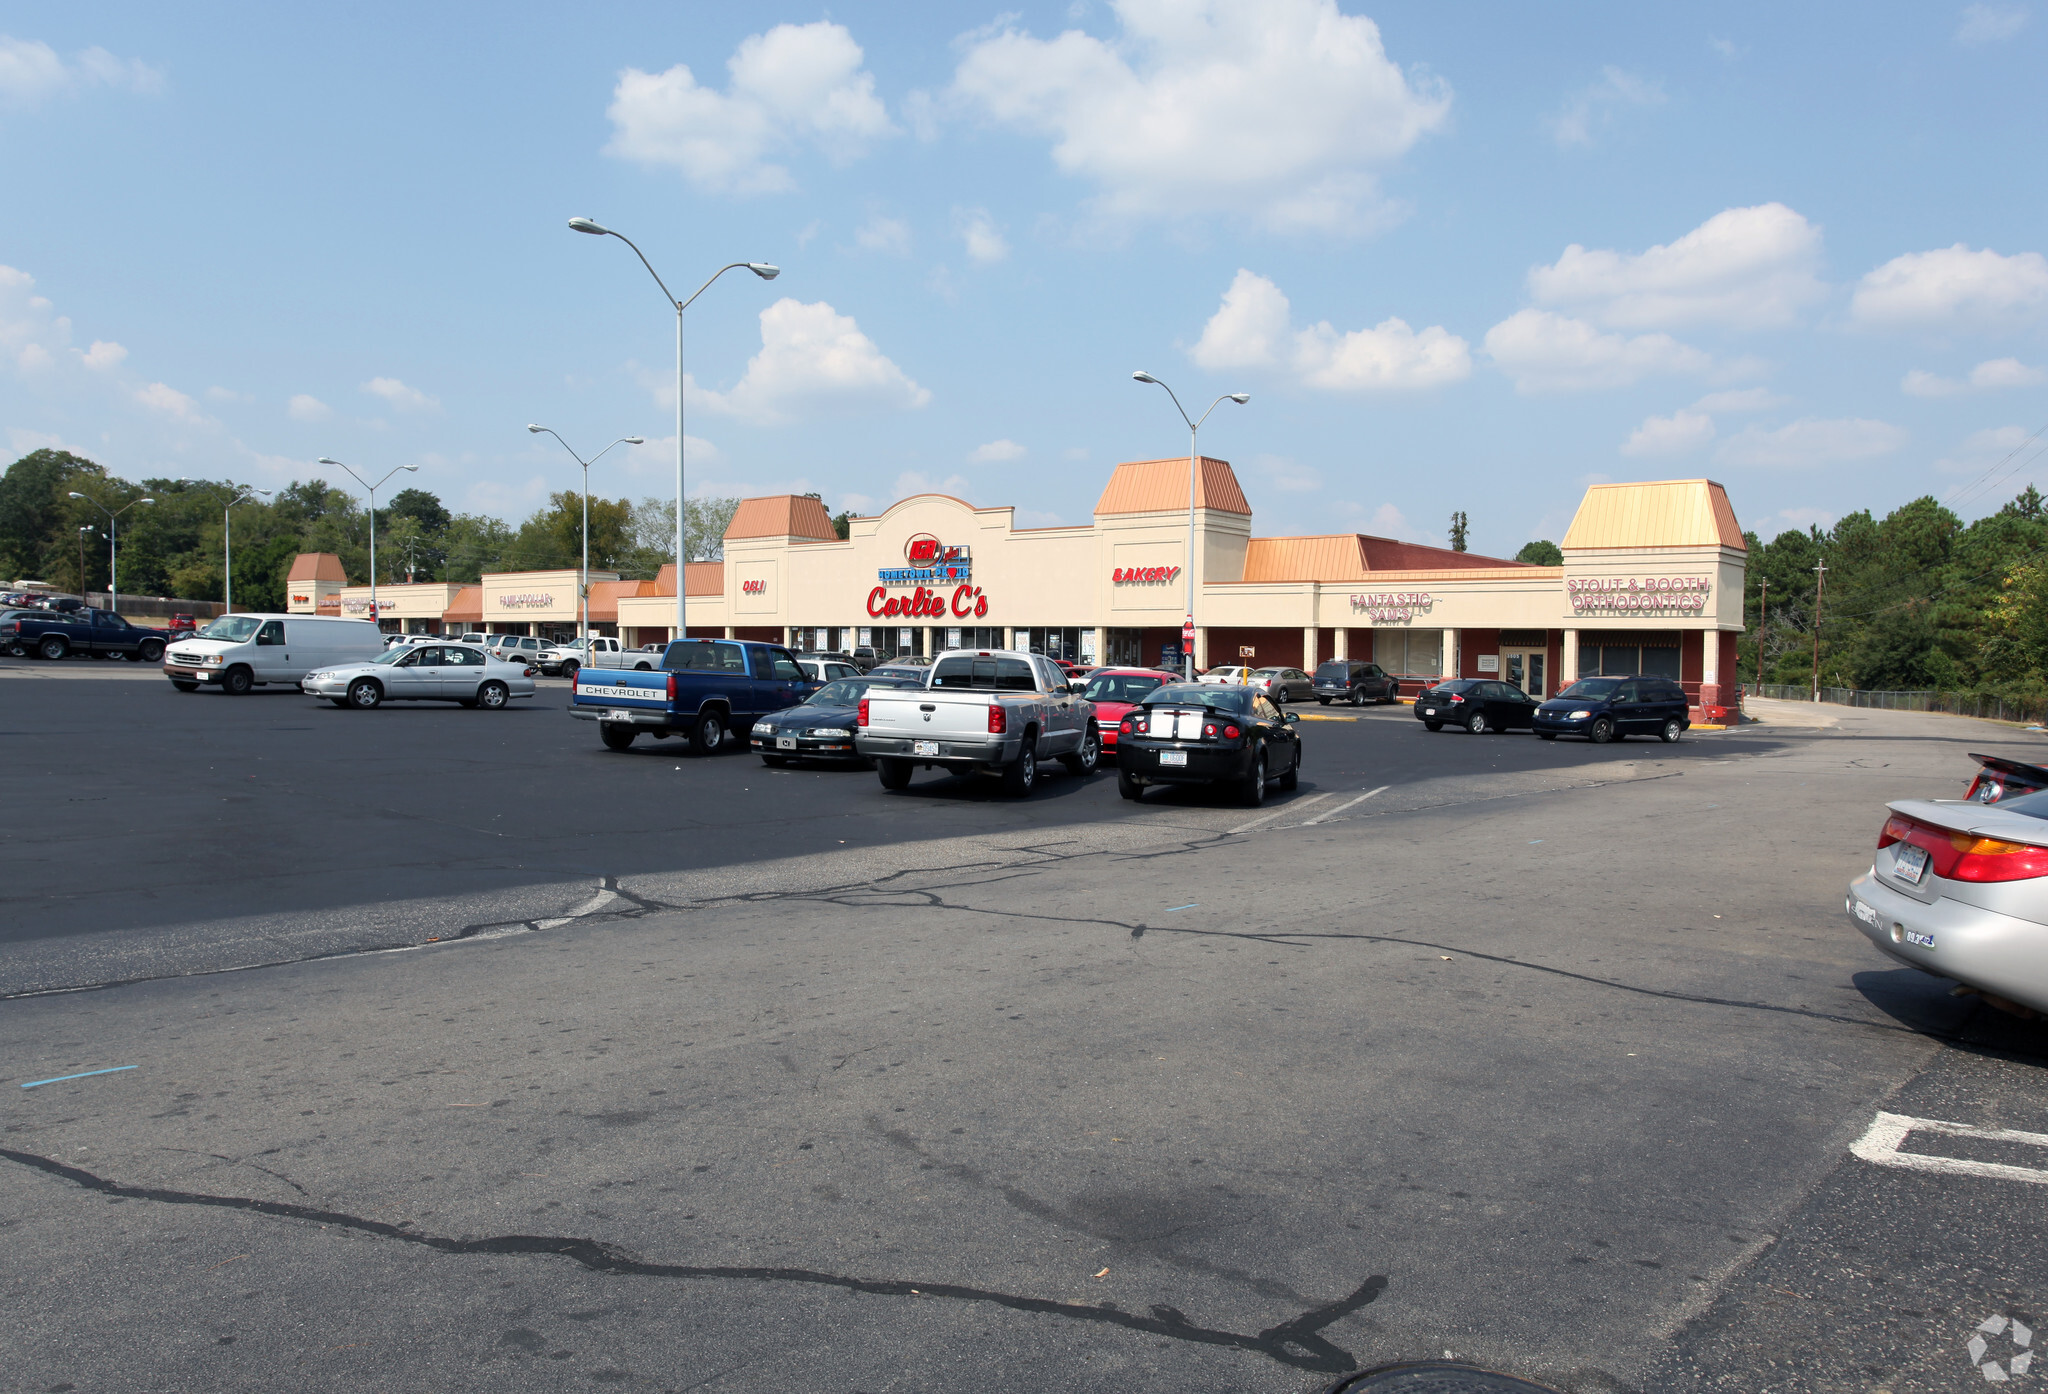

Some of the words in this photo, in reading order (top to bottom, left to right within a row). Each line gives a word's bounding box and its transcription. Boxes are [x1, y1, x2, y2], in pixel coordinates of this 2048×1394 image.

[909, 540, 937, 560] IGA
[878, 569, 931, 580] HOMETOWN
[935, 567, 969, 579] PRUD
[1112, 566, 1179, 582] BAKERY
[742, 580, 765, 592] DELI
[1567, 578, 1622, 592] STOUT
[1627, 578, 1640, 591] &
[1645, 577, 1709, 591] BOOTH
[500, 594, 523, 605] FAMILY
[522, 592, 551, 604] DOLLAR
[867, 586, 946, 617] Carlie
[951, 584, 988, 617] C's
[1350, 593, 1431, 606] FANTASTIC
[1571, 595, 1703, 609] ORTHODONTICS
[1369, 609, 1410, 620] SAM'S
[585, 686, 658, 698] CHEVROLET
